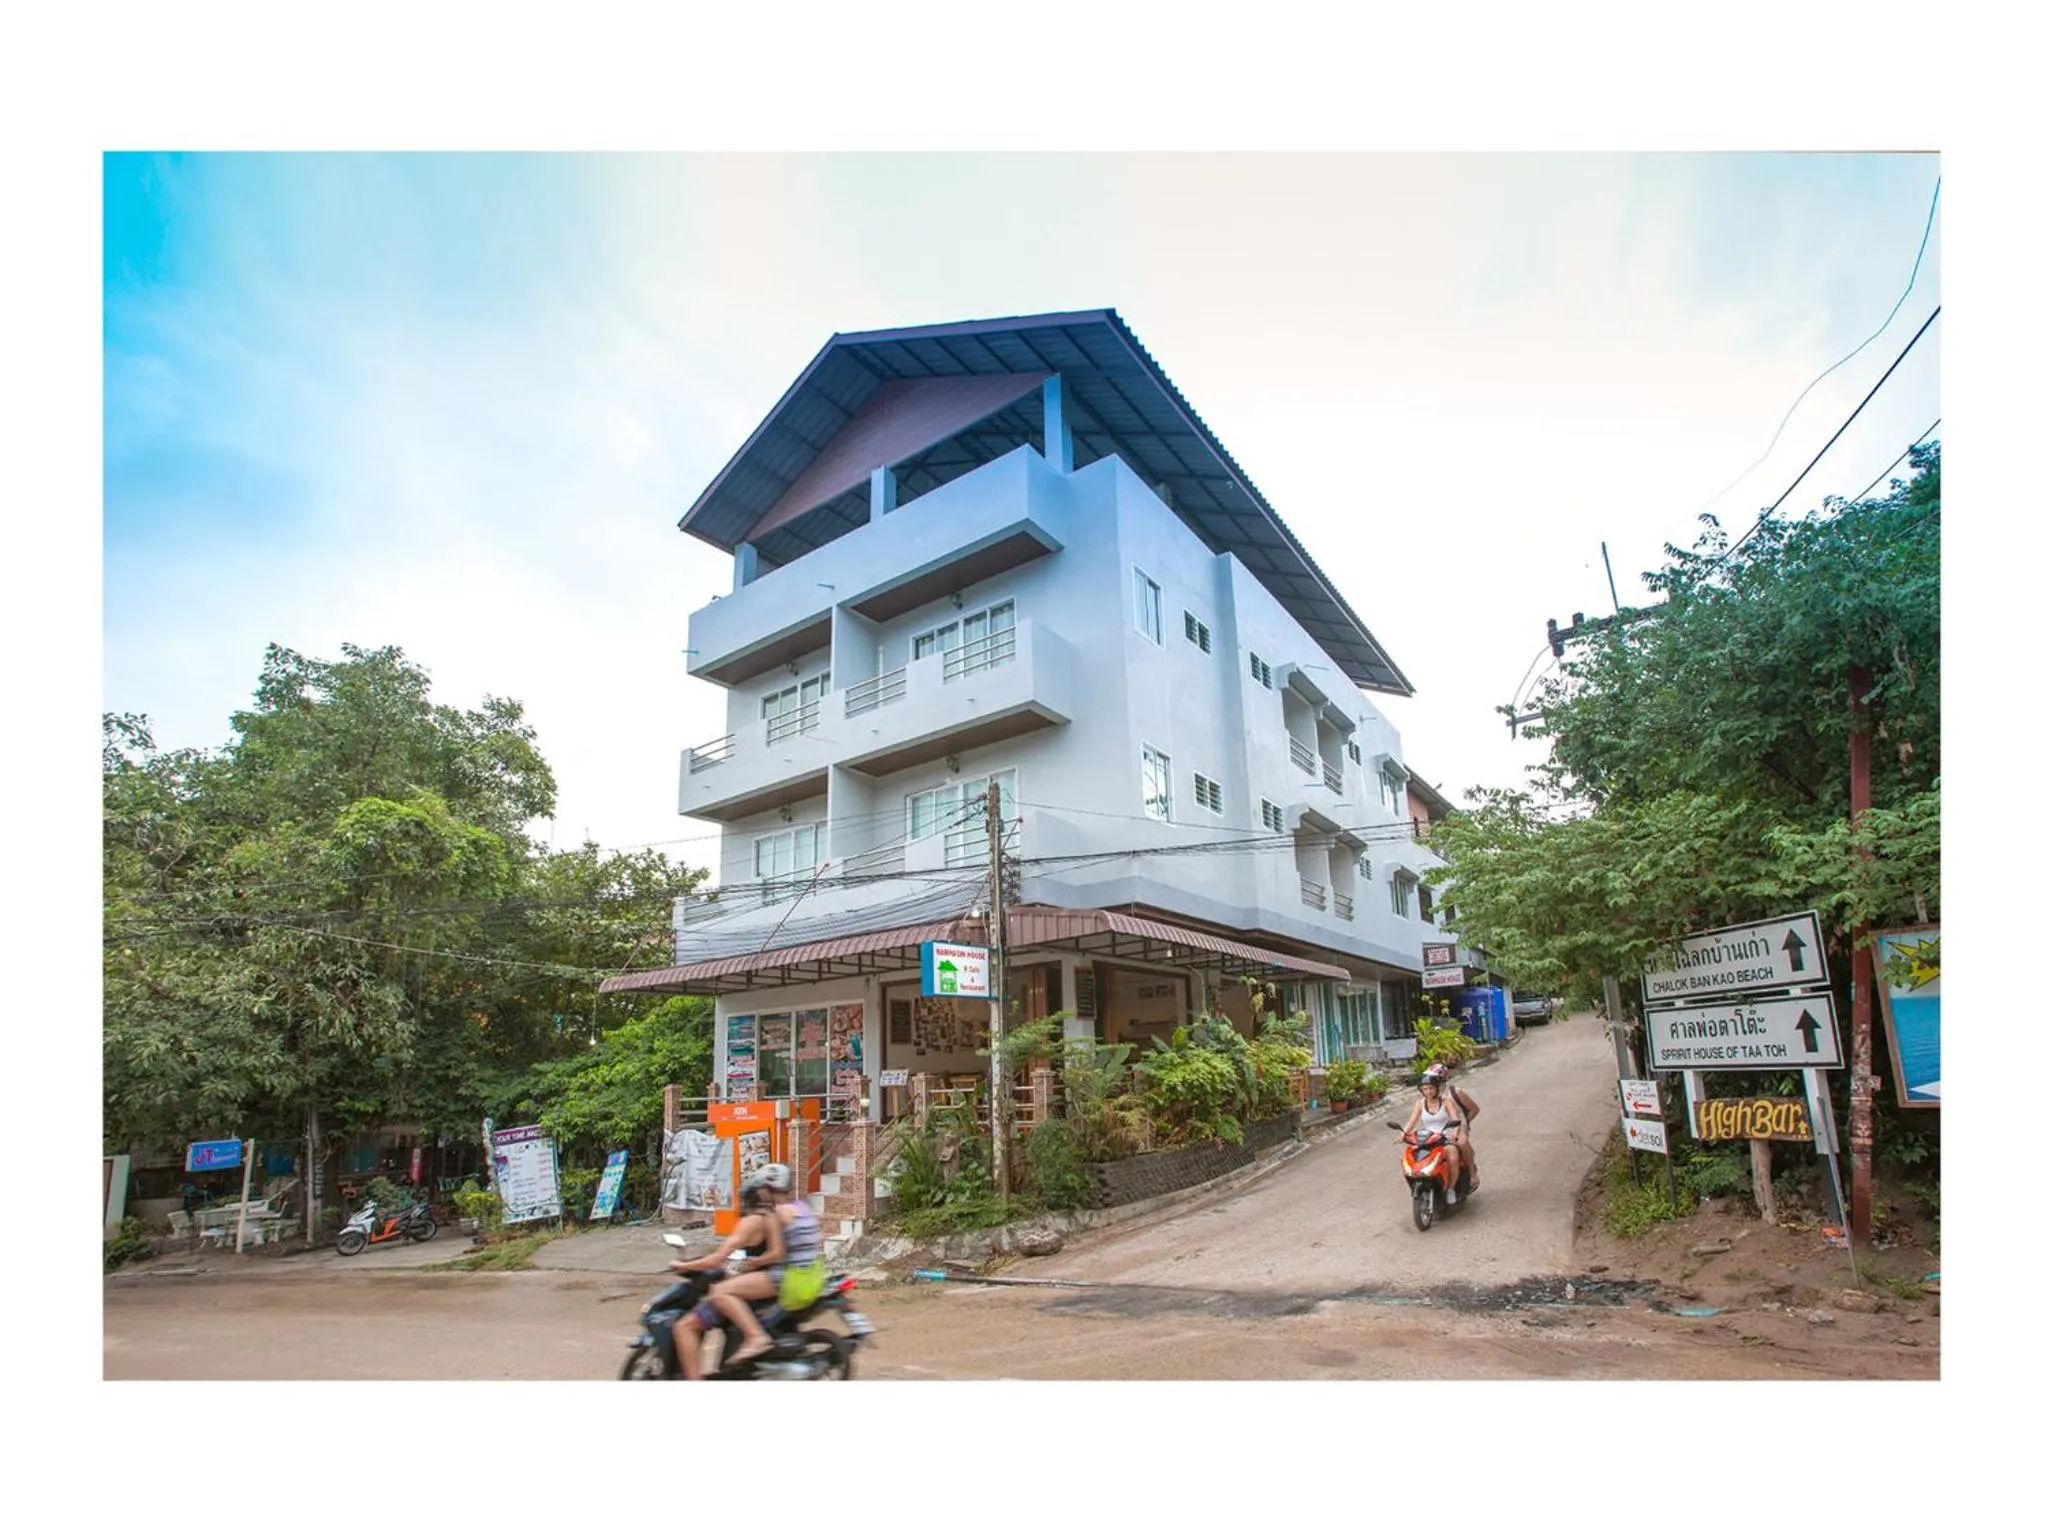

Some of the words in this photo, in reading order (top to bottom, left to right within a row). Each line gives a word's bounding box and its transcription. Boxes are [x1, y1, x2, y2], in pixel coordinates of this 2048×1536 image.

[967, 951, 986, 960] HOUSE
[1653, 977, 1688, 993] CHALOK
[1690, 974, 1711, 989] BAN
[1712, 971, 1736, 985] KAO
[1737, 966, 1774, 983] BEACH
[1694, 1047, 1725, 1059] HOUSE
[1726, 1046, 1739, 1058] OF
[1741, 1045, 1763, 1058] TAA
[1764, 1044, 1788, 1057] TOH
